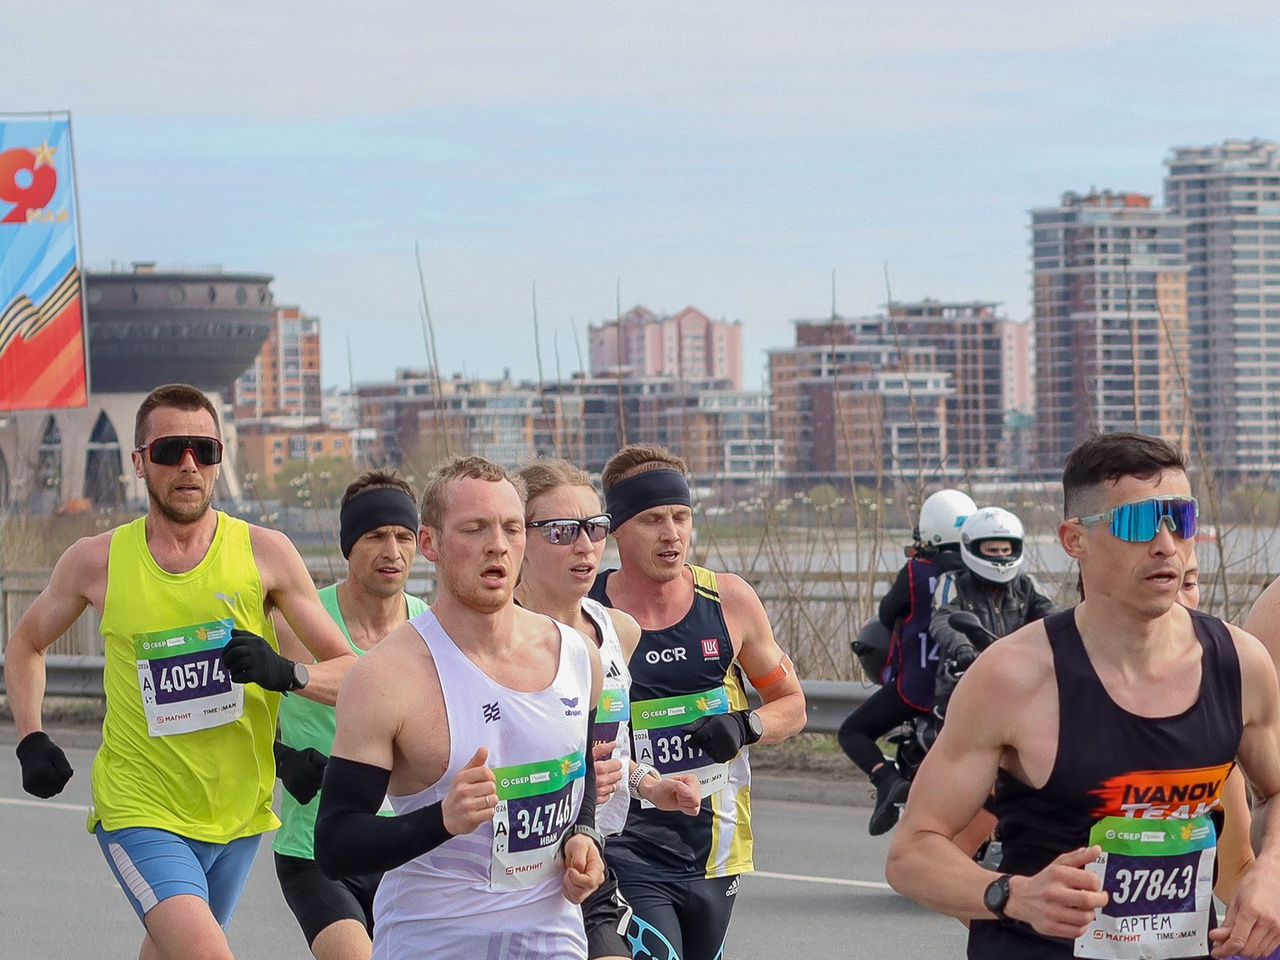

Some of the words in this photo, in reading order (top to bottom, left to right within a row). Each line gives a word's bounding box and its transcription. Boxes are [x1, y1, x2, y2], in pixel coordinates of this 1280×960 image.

[0, 147, 58, 224] 9
[645, 647, 688, 664] OCR
[160, 658, 226, 693] 40574
[143, 677, 153, 691] A
[165, 712, 192, 722] МАГНИТ
[635, 733, 648, 741] 2026
[641, 748, 652, 760] A
[511, 776, 530, 786] СБЕР
[1123, 779, 1221, 805] IVANOV
[494, 804, 507, 813] 026
[517, 793, 571, 840] 34746
[495, 821, 508, 838] A
[1117, 832, 1140, 841] СБЕР
[540, 832, 558, 846] ИВАН
[515, 862, 544, 873] МАГНИТ
[1112, 865, 1194, 904] 37843
[1119, 913, 1172, 933] АРТЁМ
[1105, 932, 1141, 942] МАГНИТ
